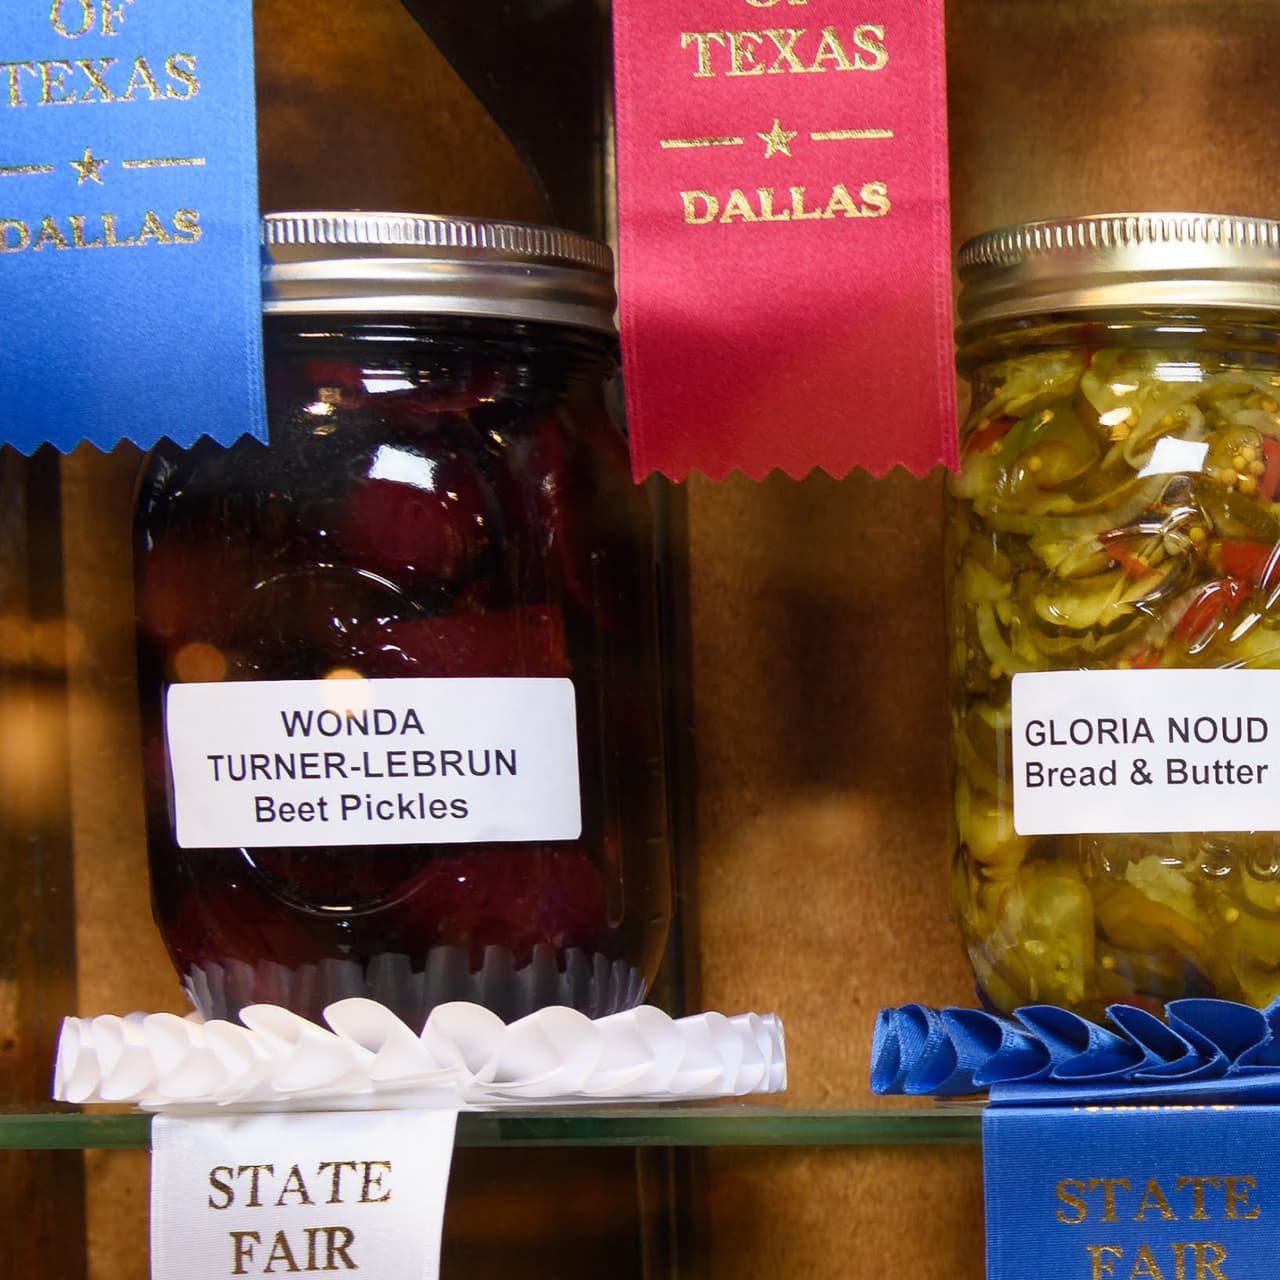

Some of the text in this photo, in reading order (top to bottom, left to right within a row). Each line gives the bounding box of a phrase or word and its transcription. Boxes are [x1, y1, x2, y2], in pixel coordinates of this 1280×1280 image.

[680, 23, 889, 77] TEXAS
[0, 52, 201, 107] TEXAS
[680, 181, 891, 224] DALLAS
[0, 208, 203, 254] DALLAS
[281, 708, 425, 737] WONDA
[1025, 718, 1155, 746] GLORIA
[1168, 716, 1269, 744] NOUD
[207, 748, 517, 781] TURNER-LEBRUN
[1025, 759, 1117, 788] Bread
[1130, 758, 1154, 786] &
[1166, 758, 1269, 786] Butter
[255, 793, 469, 823] Beet Pickles
[207, 1160, 392, 1210] STATE
[1055, 1175, 1261, 1224] STATE
[229, 1226, 359, 1275] FAIR
